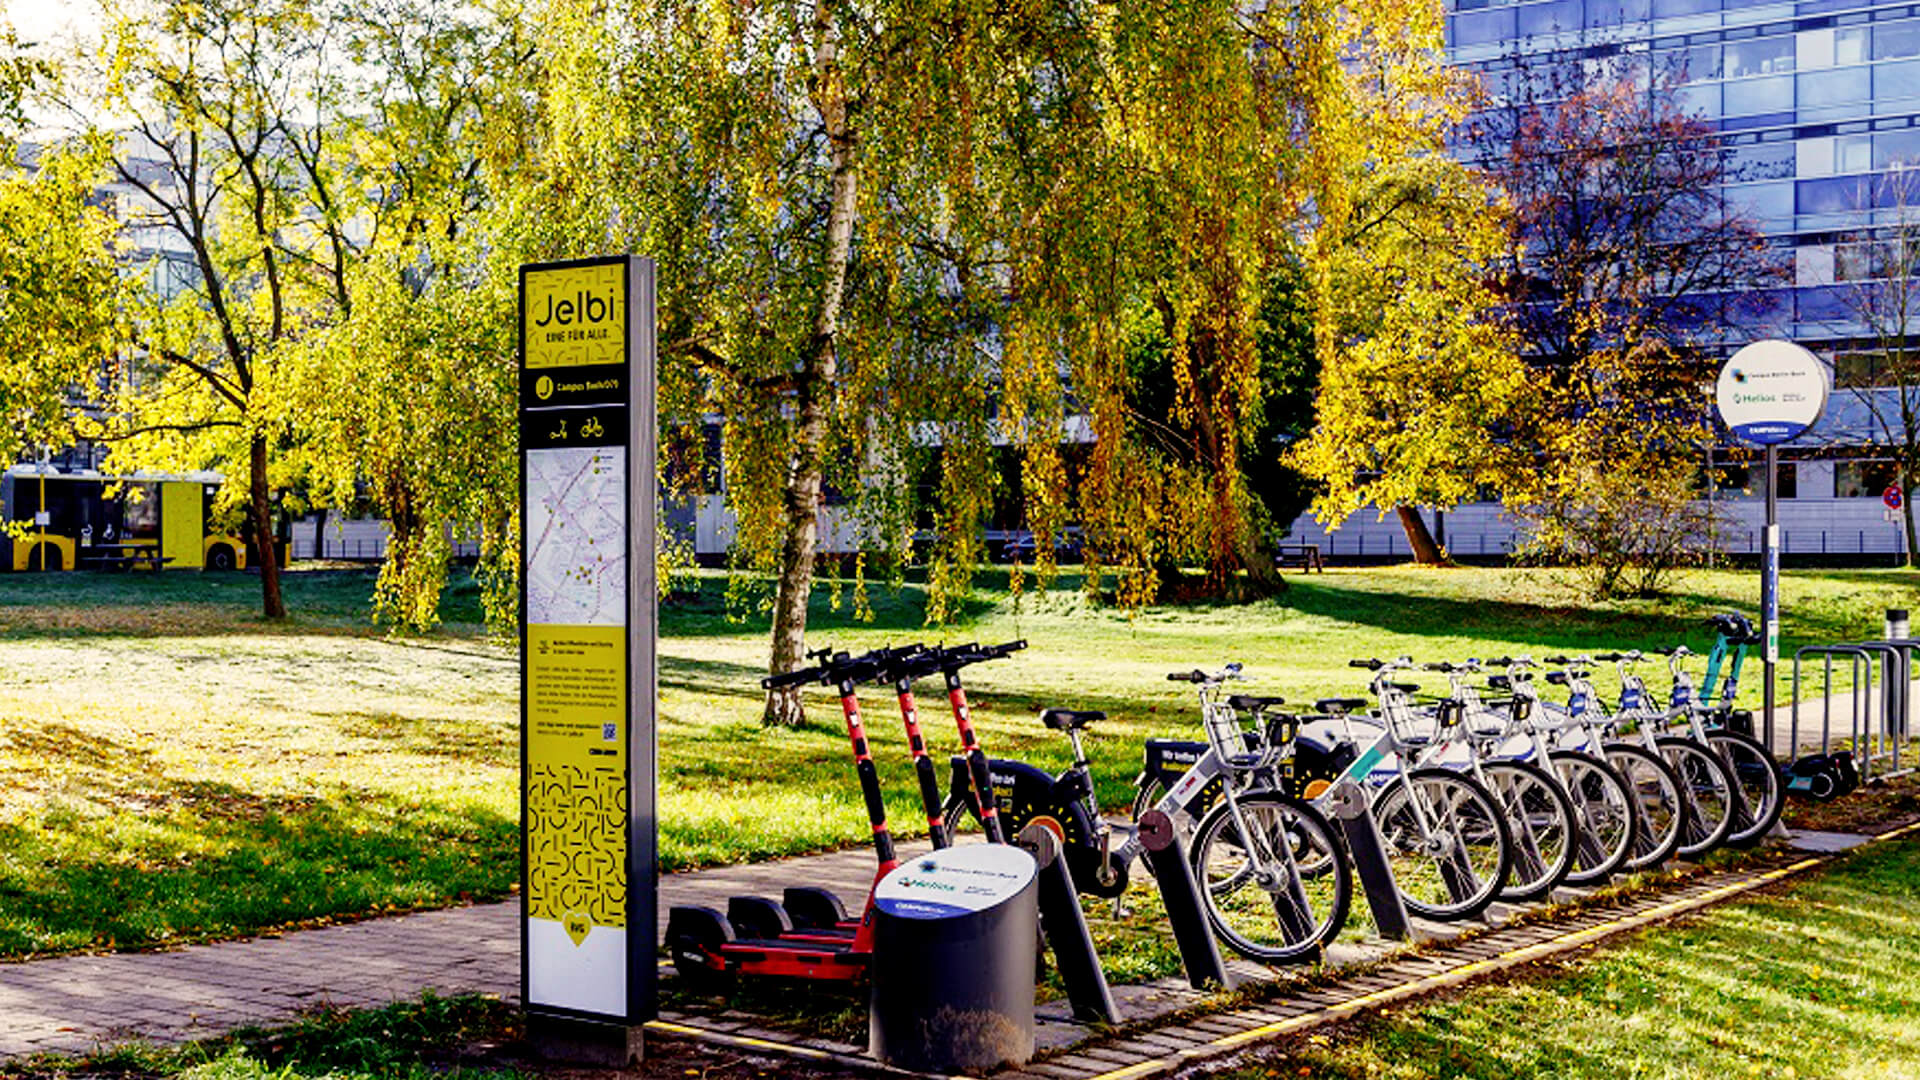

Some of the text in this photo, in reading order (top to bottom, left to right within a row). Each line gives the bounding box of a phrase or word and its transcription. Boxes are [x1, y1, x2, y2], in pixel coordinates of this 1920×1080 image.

[535, 288, 615, 327] Jelbi
[546, 328, 611, 343] EINE FÜR ALLE.
[557, 382, 585, 393] Campus
[1743, 394, 1776, 403] Helios
[910, 879, 956, 892] Helios
